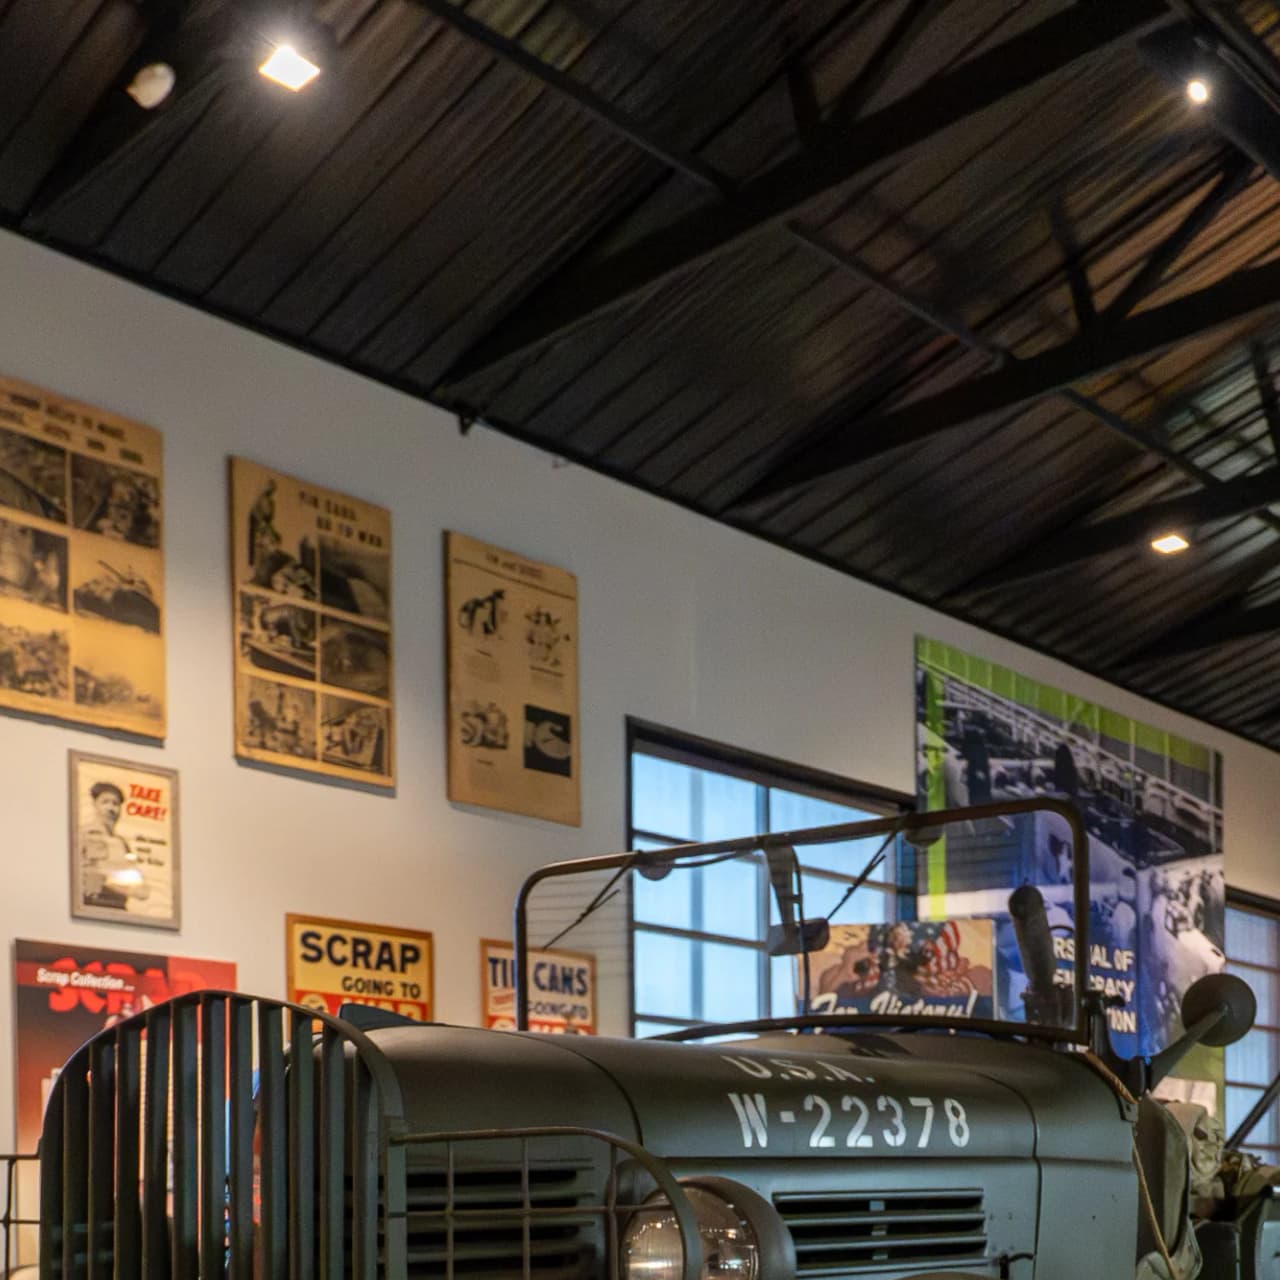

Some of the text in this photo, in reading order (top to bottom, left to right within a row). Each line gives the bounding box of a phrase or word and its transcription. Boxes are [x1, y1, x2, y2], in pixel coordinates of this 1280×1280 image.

[129, 783, 162, 803] TAKE
[126, 802, 167, 821] CARE!
[300, 930, 421, 974] SCRAP
[1114, 948, 1135, 972] OF
[37, 968, 69, 987] Scrap
[342, 975, 421, 999] GOING TO
[533, 962, 588, 996] CANS
[720, 1055, 875, 1083] U.S.A.
[727, 1093, 970, 1148] W-22378
